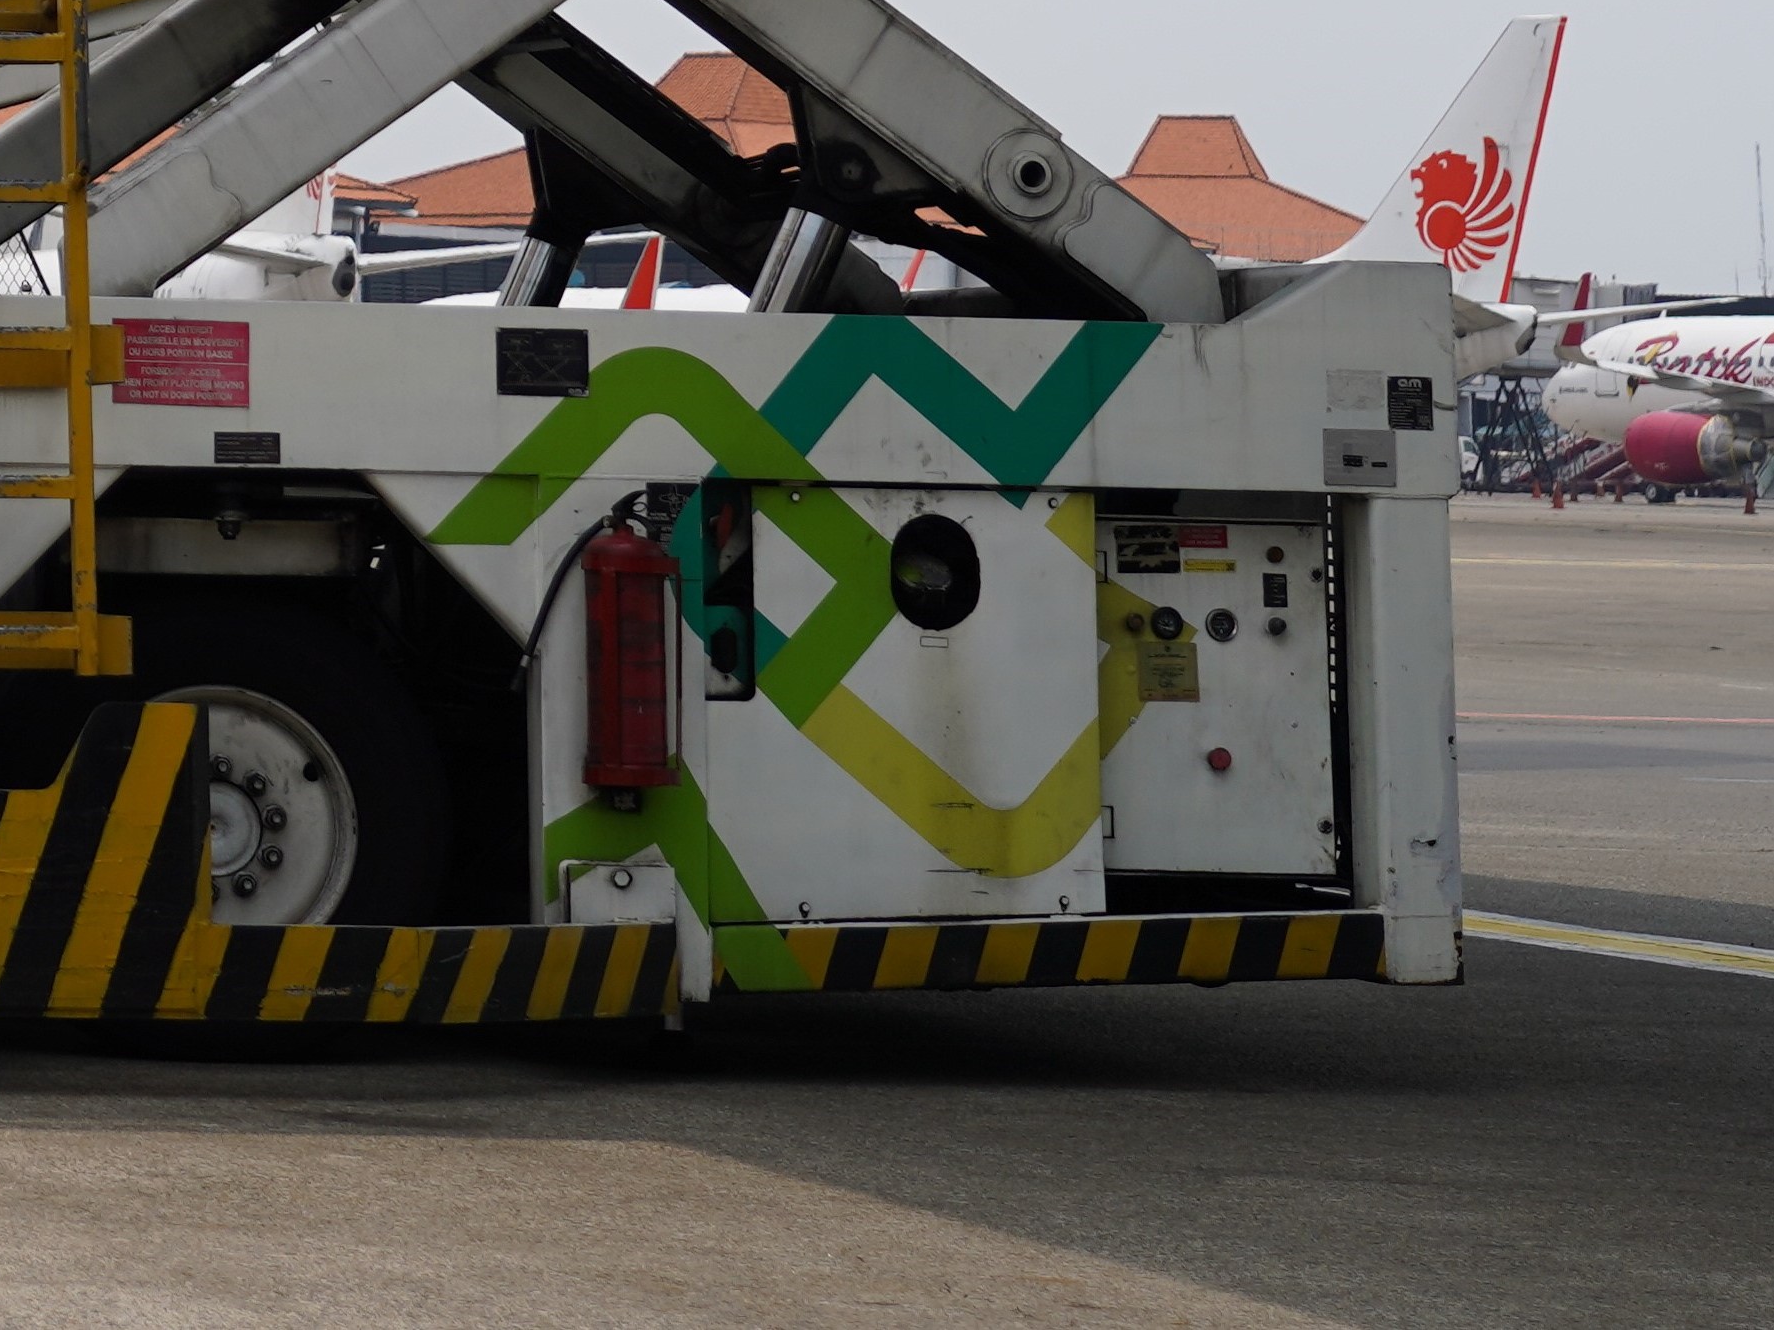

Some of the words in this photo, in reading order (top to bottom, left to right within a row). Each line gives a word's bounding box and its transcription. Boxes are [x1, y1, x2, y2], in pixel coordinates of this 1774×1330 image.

[167, 349, 204, 358] POSITION
[214, 380, 245, 389] MOVING
[143, 390, 158, 398] NOT
[196, 391, 232, 400] POSITION
